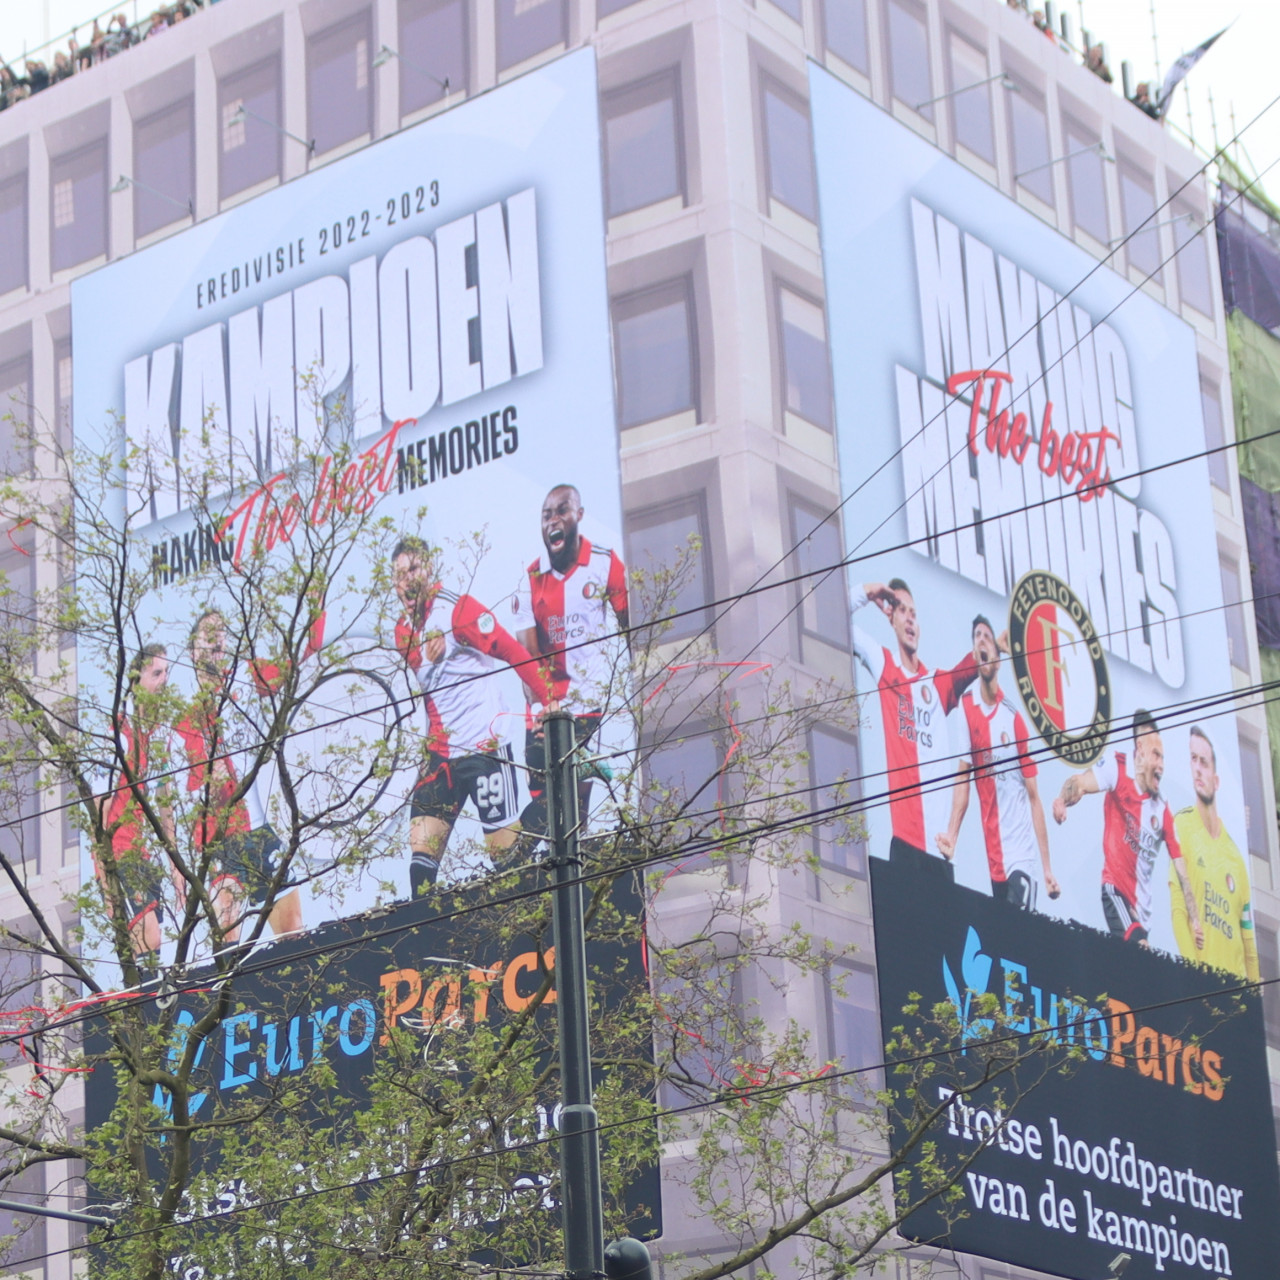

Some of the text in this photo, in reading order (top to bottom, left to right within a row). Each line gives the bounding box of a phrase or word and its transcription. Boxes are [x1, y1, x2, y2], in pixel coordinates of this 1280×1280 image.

[196, 179, 441, 309] EREDIVISIE 2022-2023
[123, 186, 544, 531] KAMPIOEN
[947, 369, 1121, 502] The best
[152, 404, 519, 586] MAKING The best MEMORIES
[1012, 572, 1103, 661] FEYENOORD
[898, 719, 933, 750] Parcs
[476, 771, 503, 808] 29
[1203, 880, 1231, 916] Euro
[1203, 906, 1234, 941] Parcs
[937, 1086, 1244, 1221] Trotse hoofdpartner
[966, 1171, 1233, 1277] van de kampioen
